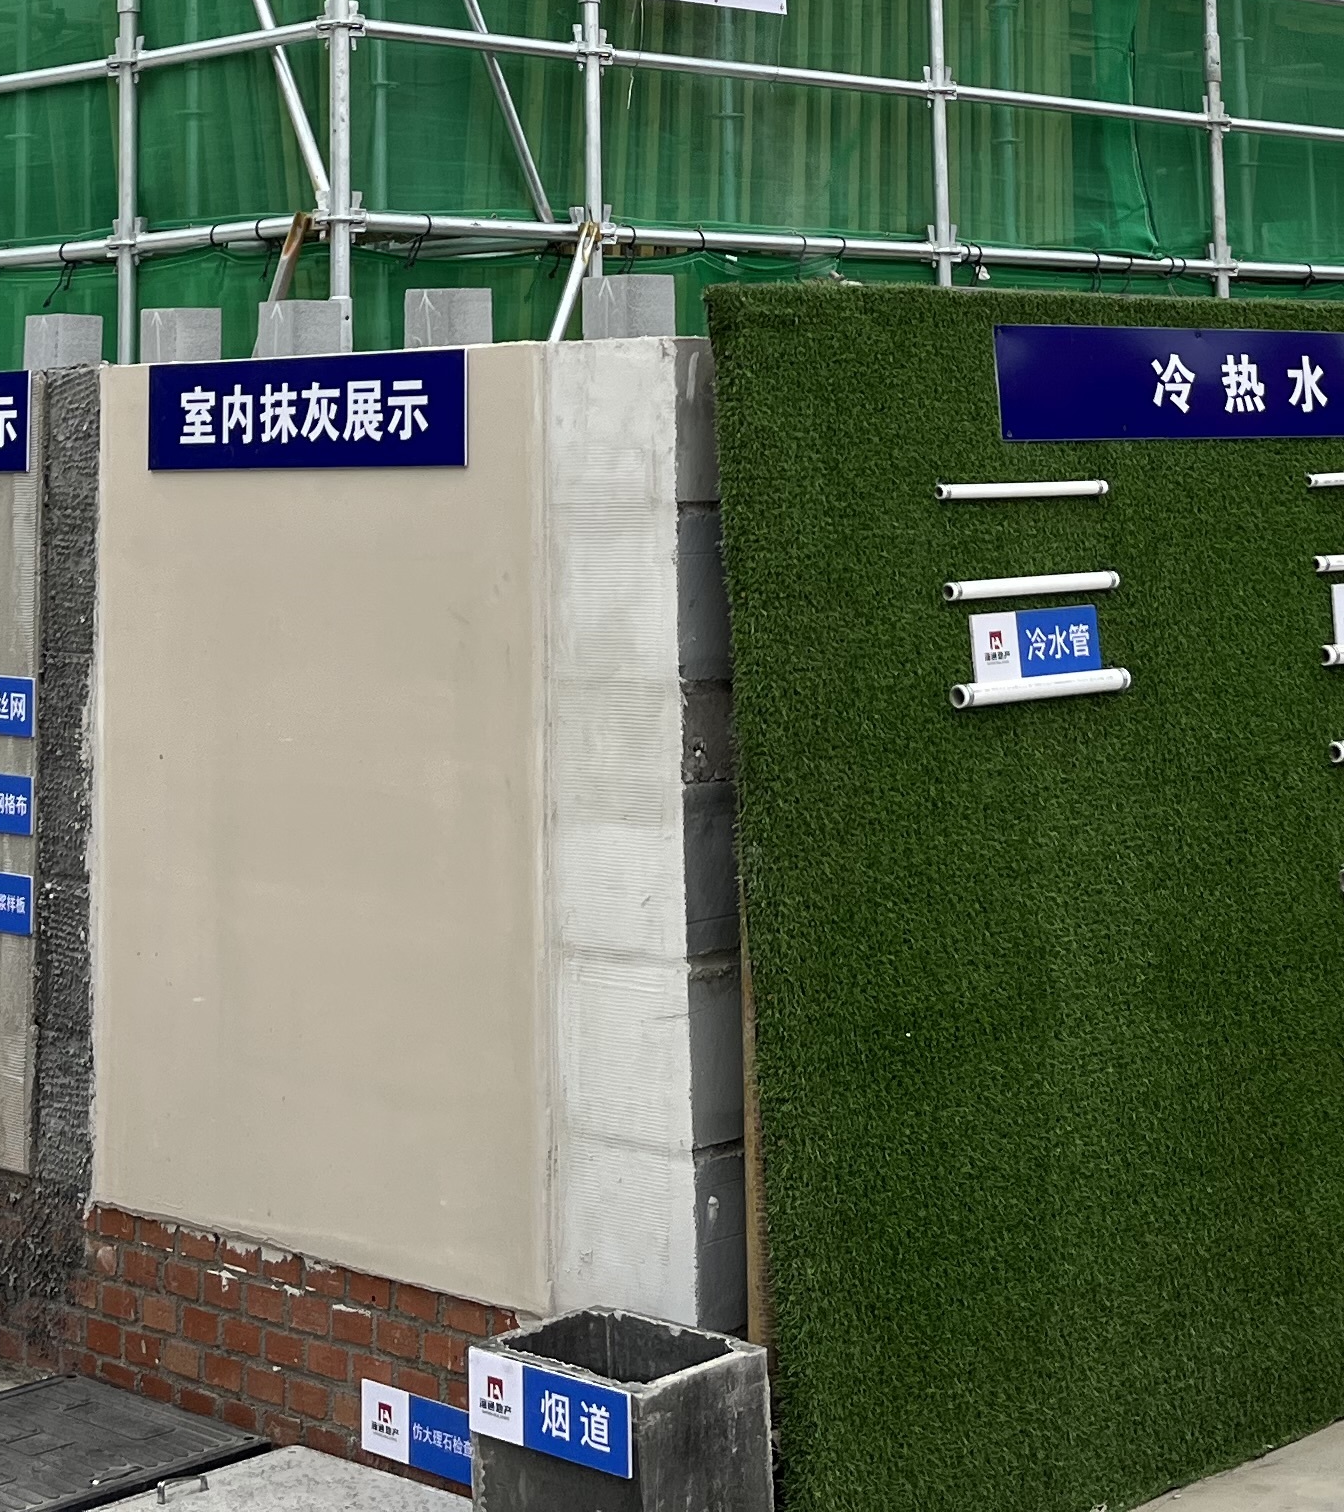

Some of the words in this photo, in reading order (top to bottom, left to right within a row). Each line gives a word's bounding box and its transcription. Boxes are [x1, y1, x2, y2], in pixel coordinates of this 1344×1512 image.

[179, 379, 429, 446] 室内抹灰展示
[1025, 623, 1090, 661] 冷水管
[540, 1389, 611, 1453] 烟道
